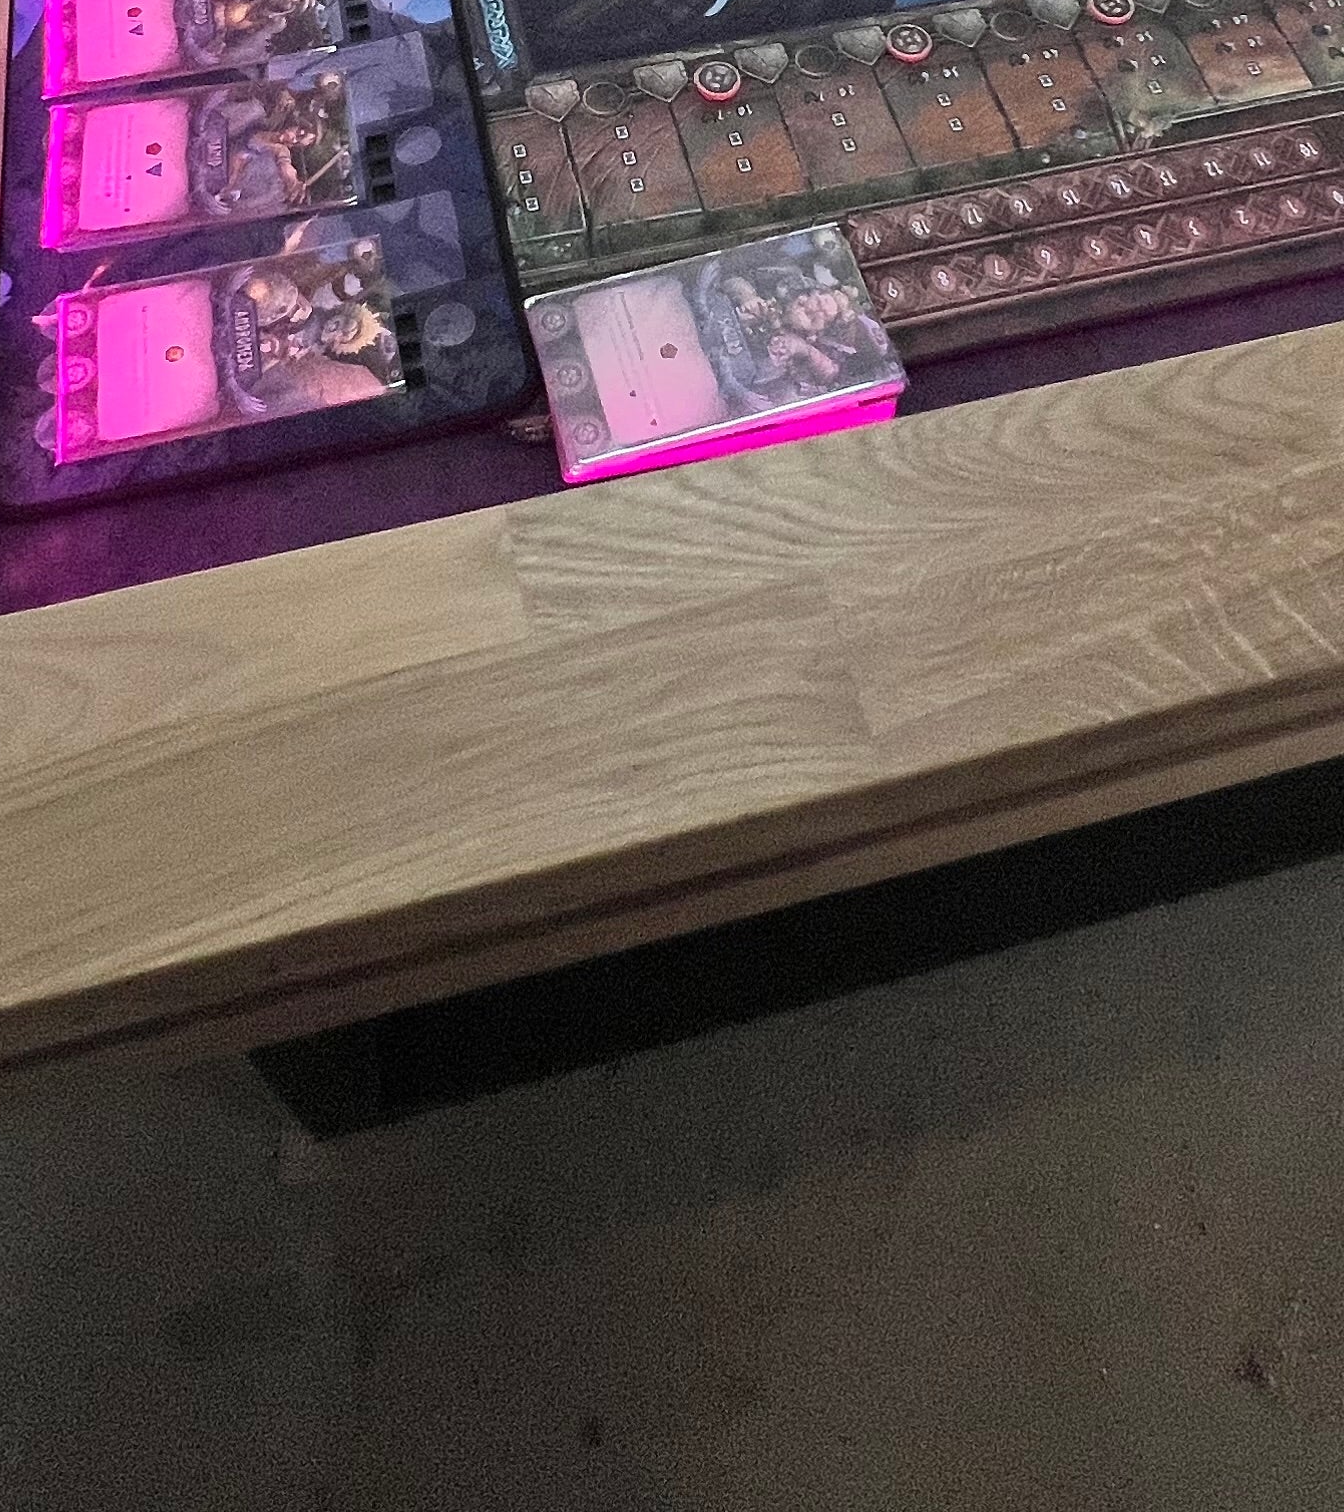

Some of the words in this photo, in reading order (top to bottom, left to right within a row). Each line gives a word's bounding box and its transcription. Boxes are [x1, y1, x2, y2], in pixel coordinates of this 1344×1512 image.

[1299, 142, 1318, 157] 10
[1253, 152, 1271, 166] 11
[1204, 161, 1223, 176] 12
[1111, 179, 1130, 195] 14
[1062, 189, 1080, 206] 15
[1014, 199, 1032, 214] 16
[967, 208, 983, 225] 17
[911, 220, 930, 236] 18
[864, 229, 881, 246] 19
